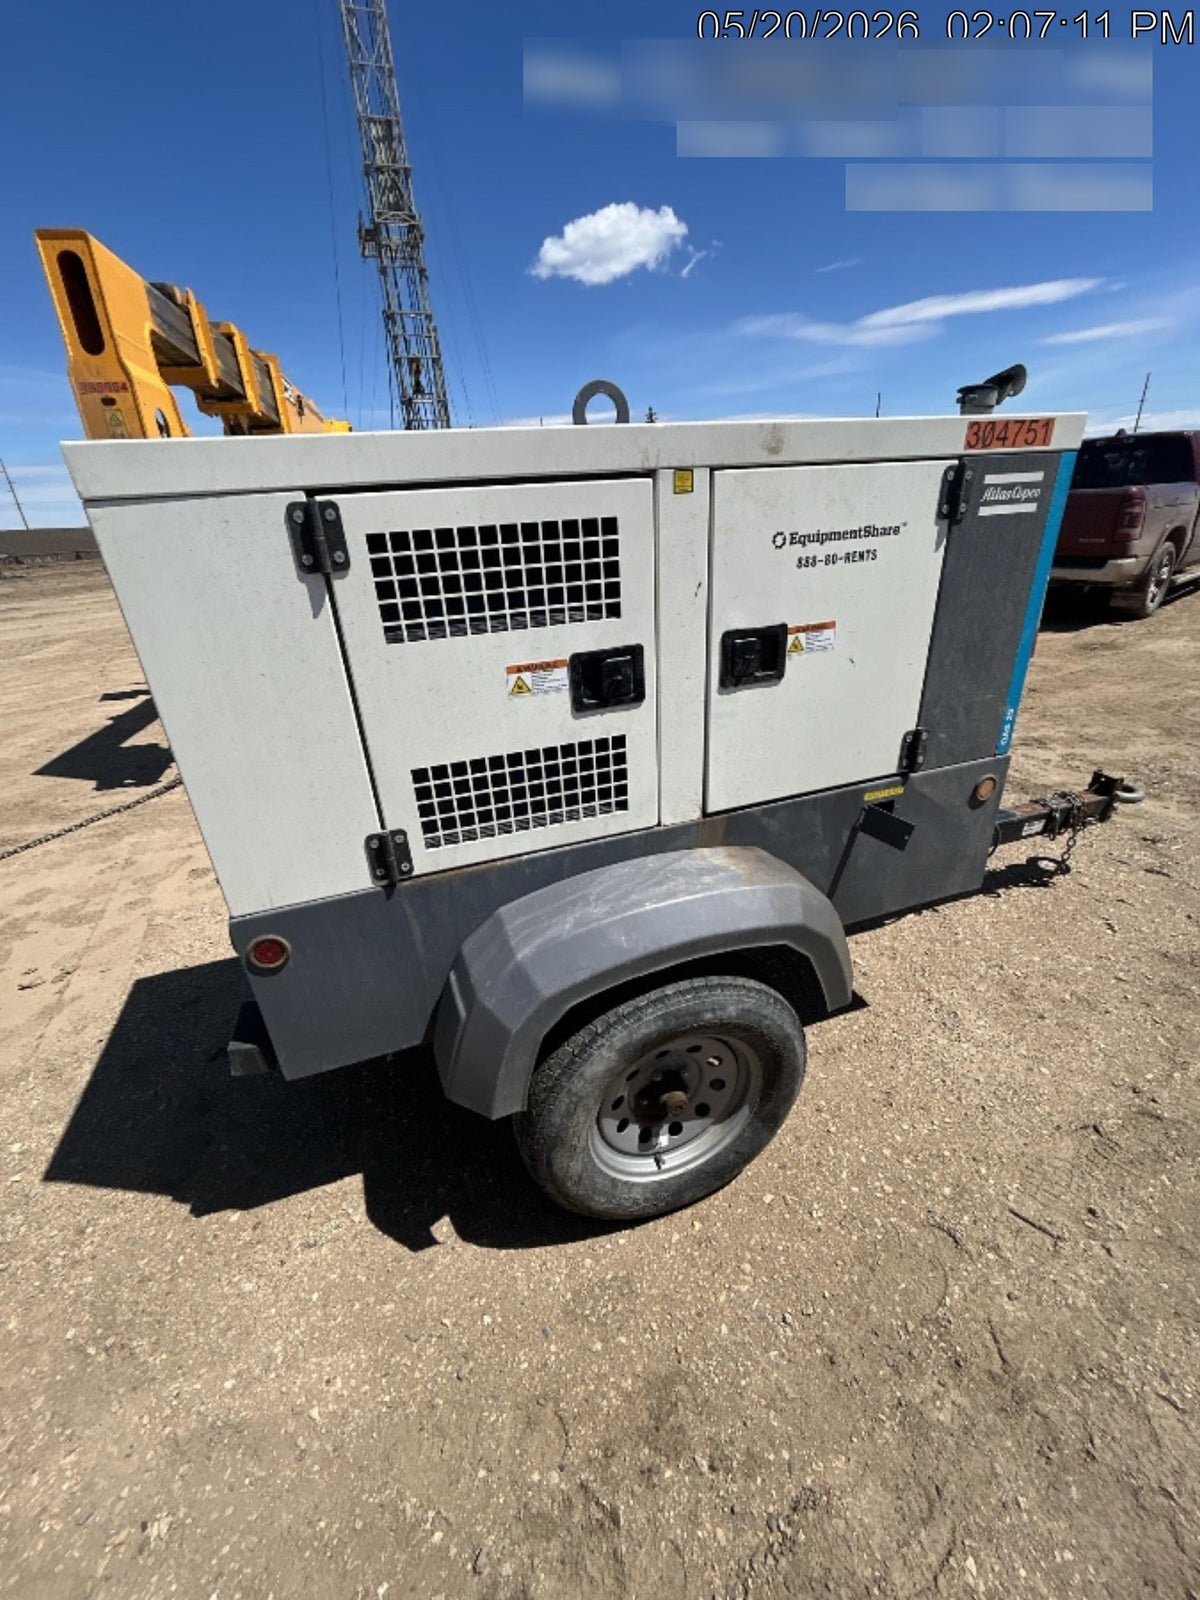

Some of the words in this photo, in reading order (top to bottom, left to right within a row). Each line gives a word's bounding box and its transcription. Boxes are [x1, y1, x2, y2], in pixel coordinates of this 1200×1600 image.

[965, 418, 1051, 449] 304751
[980, 486, 1013, 502] Atlas
[1012, 484, 1042, 502] Copco
[789, 524, 901, 548] EquipmentShare
